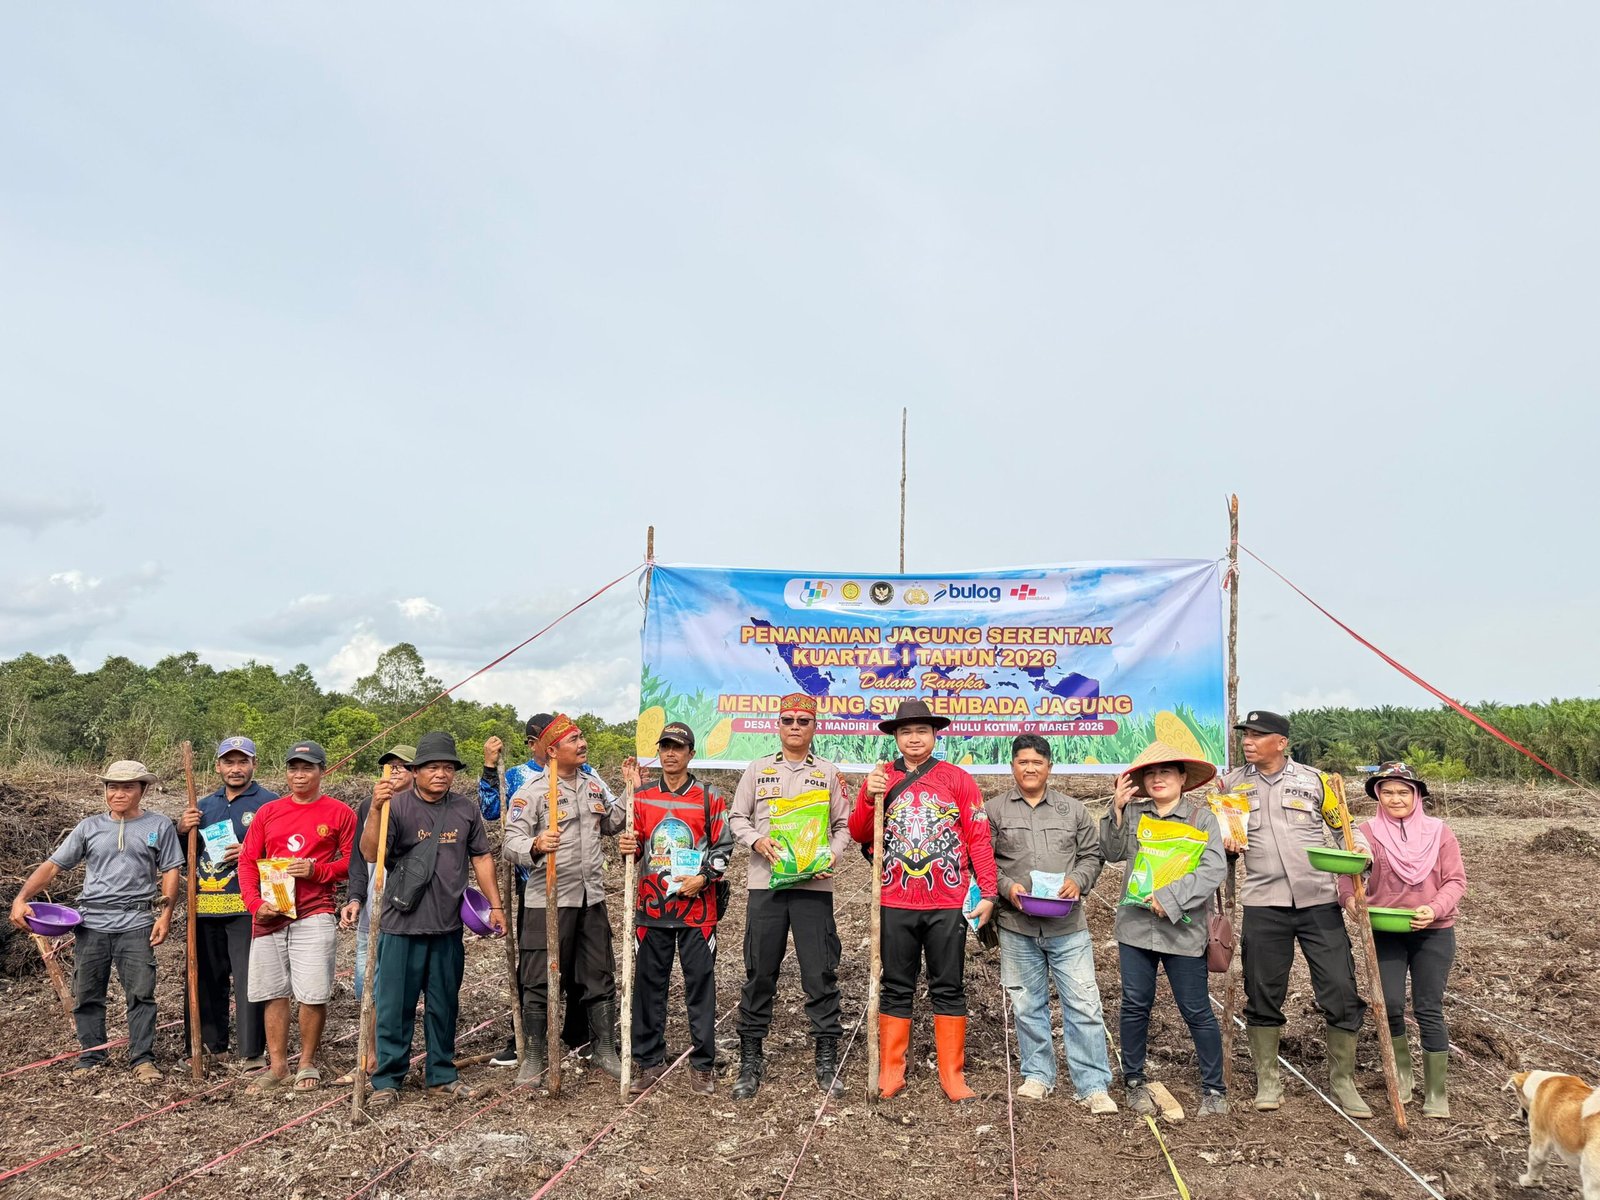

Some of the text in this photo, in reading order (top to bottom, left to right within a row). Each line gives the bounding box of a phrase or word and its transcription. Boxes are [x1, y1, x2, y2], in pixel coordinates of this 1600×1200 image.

[949, 583, 1001, 603] bulog
[741, 626, 1113, 645] PENANAMAN JAGUNG SERENTAK
[792, 648, 1056, 668] KUARTAL I TAHUN 2026
[860, 672, 986, 695] Dalam Rangka
[718, 694, 1132, 716] MENDUNG SWSEMBADA JAGUNG
[744, 720, 771, 730] DESA
[825, 721, 869, 732] MANDIRI
[953, 722, 981, 732] HULU
[984, 723, 1021, 733] KOTIM,
[1024, 723, 1036, 732] 07
[1039, 722, 1076, 732] MARET
[1078, 722, 1104, 732] 2026
[804, 779, 828, 788] POLRI
[1285, 788, 1312, 799] POLRI
